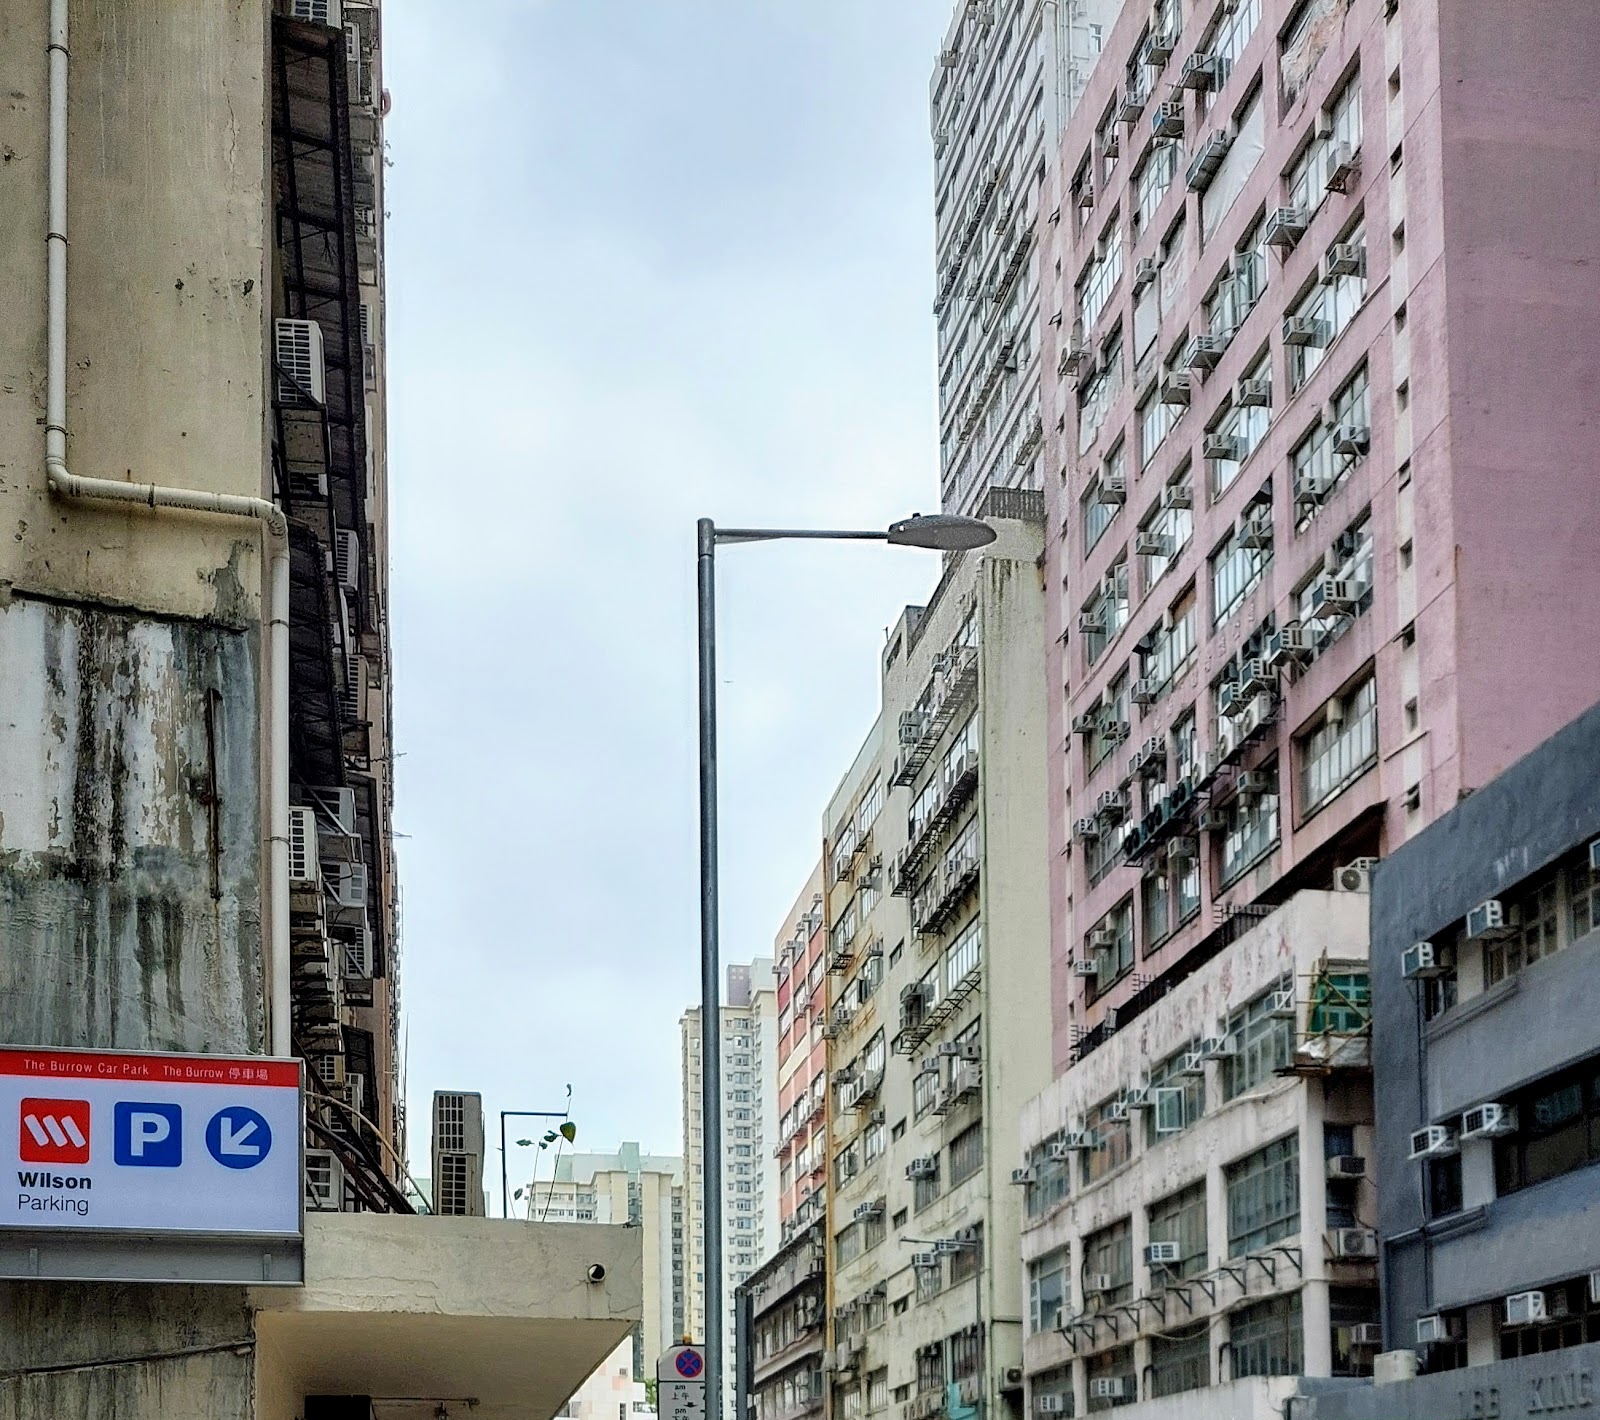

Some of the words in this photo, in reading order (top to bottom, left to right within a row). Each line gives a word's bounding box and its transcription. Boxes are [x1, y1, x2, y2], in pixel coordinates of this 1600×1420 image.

[24, 1059, 45, 1071] The
[50, 1060, 92, 1073] Burrow
[98, 1062, 118, 1074] Car
[123, 1064, 149, 1075] Park
[163, 1065, 182, 1077] The
[186, 1066, 223, 1079] Burrow
[229, 1067, 269, 1081] 停車場
[130, 1112, 171, 1157] P
[17, 1171, 92, 1190] Wilson
[18, 1194, 89, 1216] Parking
[671, 1391, 690, 1400] 上午
[1527, 1371, 1594, 1413] KING
[674, 1407, 687, 1415] pm
